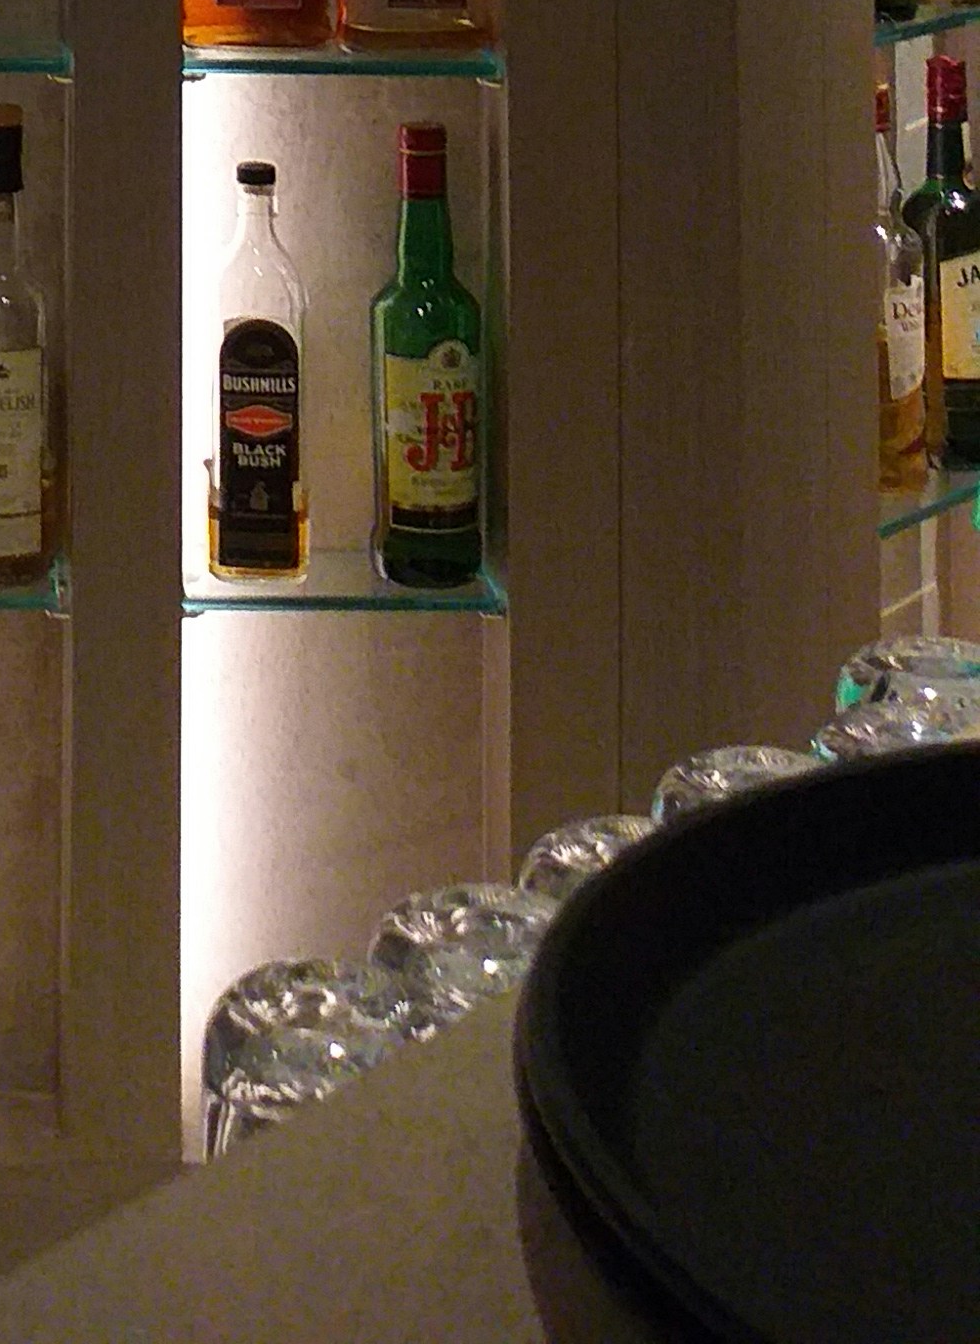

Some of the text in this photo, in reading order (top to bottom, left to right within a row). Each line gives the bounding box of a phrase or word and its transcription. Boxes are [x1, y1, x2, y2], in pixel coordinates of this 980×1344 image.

[223, 373, 296, 393] BUSHMILLS
[233, 442, 287, 457] BLACK
[237, 455, 281, 469] BUSH
